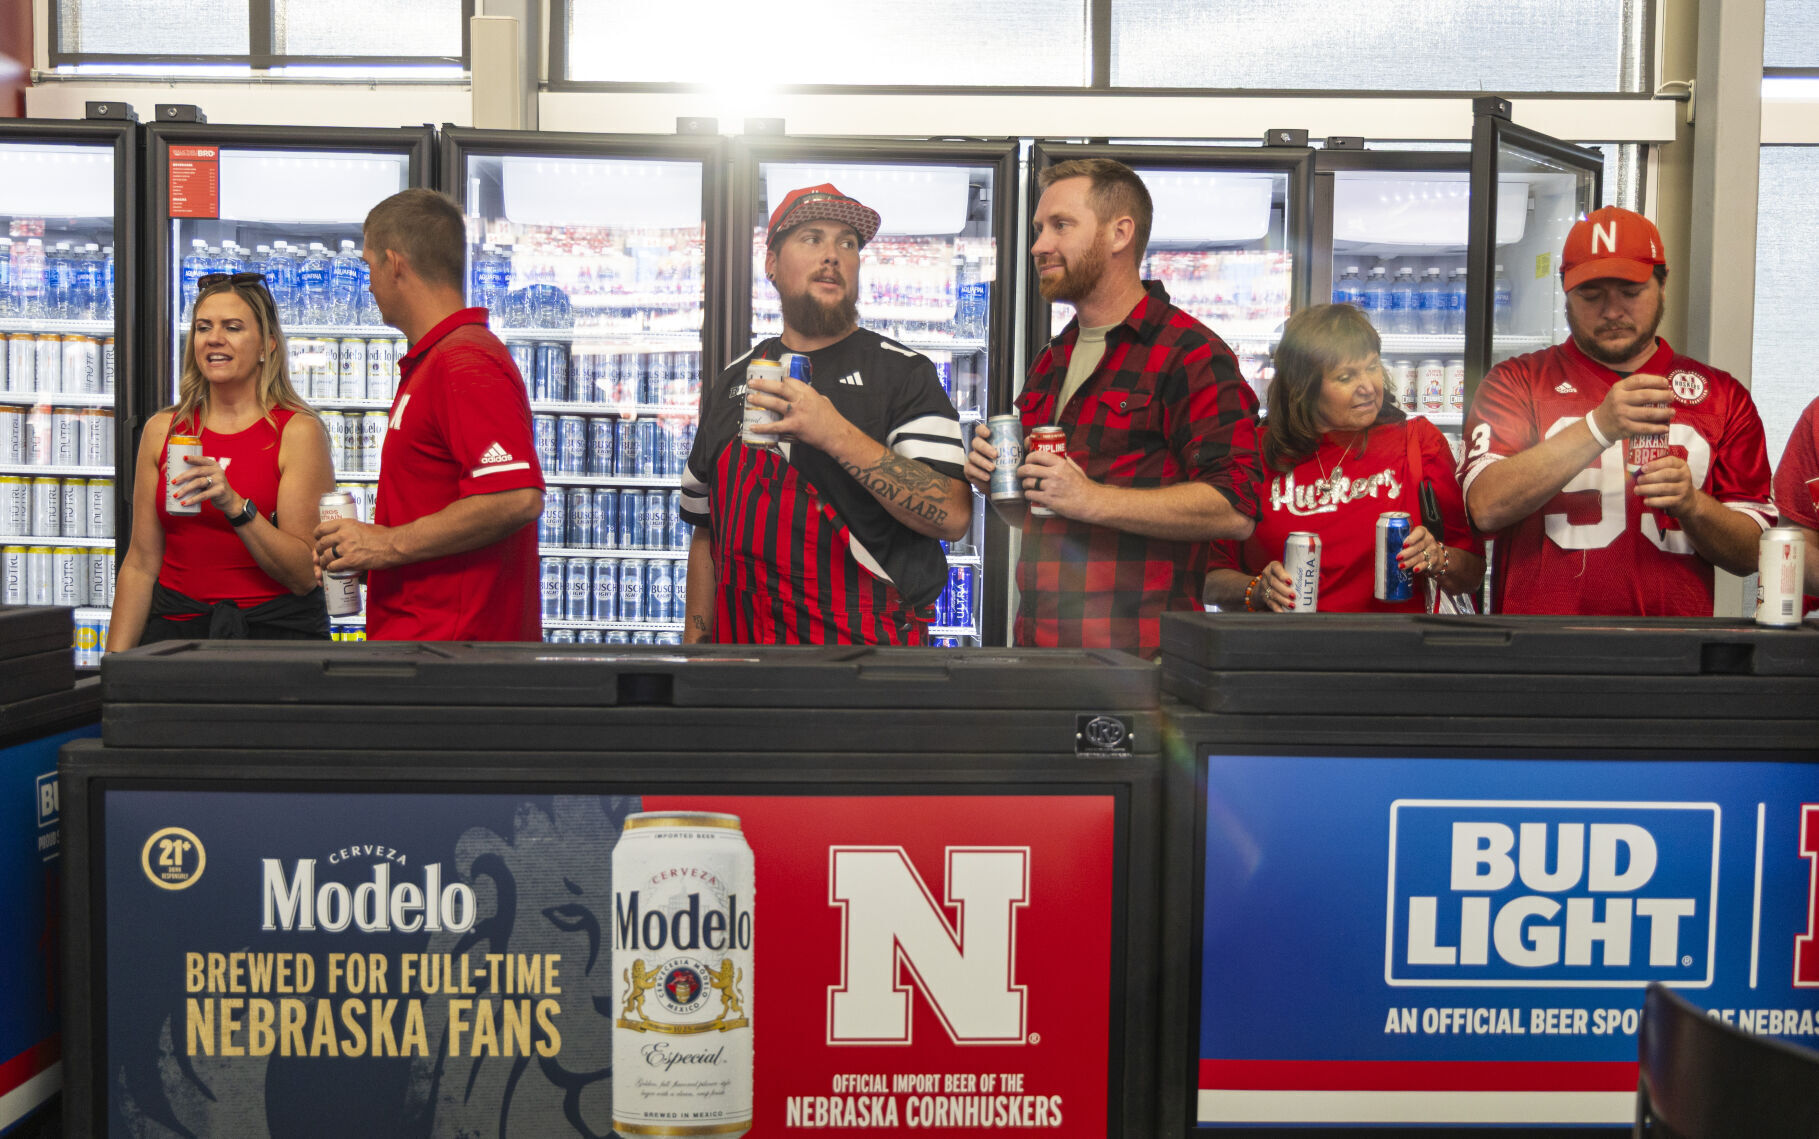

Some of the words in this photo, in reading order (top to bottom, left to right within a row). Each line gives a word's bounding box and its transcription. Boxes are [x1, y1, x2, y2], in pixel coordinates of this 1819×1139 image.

[1592, 220, 1616, 254] N
[481, 454, 512, 464] adidas
[995, 446, 1023, 459] USCH
[1038, 442, 1065, 453] ZIPLINE
[1269, 465, 1402, 516] Huskers
[1303, 558, 1316, 606] ULTRA
[159, 838, 191, 866] 21+
[328, 845, 407, 866] CERVEZA
[1450, 821, 1658, 892] BUD
[652, 867, 716, 885] CERVEZA
[262, 858, 477, 933] Modelo
[616, 890, 751, 951] Modelo
[1407, 895, 1696, 967] LIGHT
[826, 845, 1031, 1046] N
[186, 952, 315, 993] BREWED
[328, 953, 388, 994] FOR
[401, 953, 561, 994] FULL-TIME
[667, 1002, 700, 1013] MEXICO
[1384, 1007, 1417, 1034] AN
[1422, 1007, 1525, 1035] OFFICIAL
[1530, 1008, 1587, 1035] BEER
[1592, 1008, 1643, 1036] SPO
[186, 998, 429, 1057] NEBRASKA
[448, 998, 562, 1057] FANS
[641, 1042, 724, 1072] Especial
[833, 1074, 889, 1093] OFFICIAL
[893, 1074, 941, 1093] IMPORT
[944, 1074, 977, 1092] BEER
[980, 1074, 997, 1092] OF
[1000, 1074, 1024, 1092] THE
[644, 1111, 677, 1119] BREWED
[786, 1096, 899, 1128] NEBRASKA
[905, 1095, 1063, 1128] CORNHUSKERS
